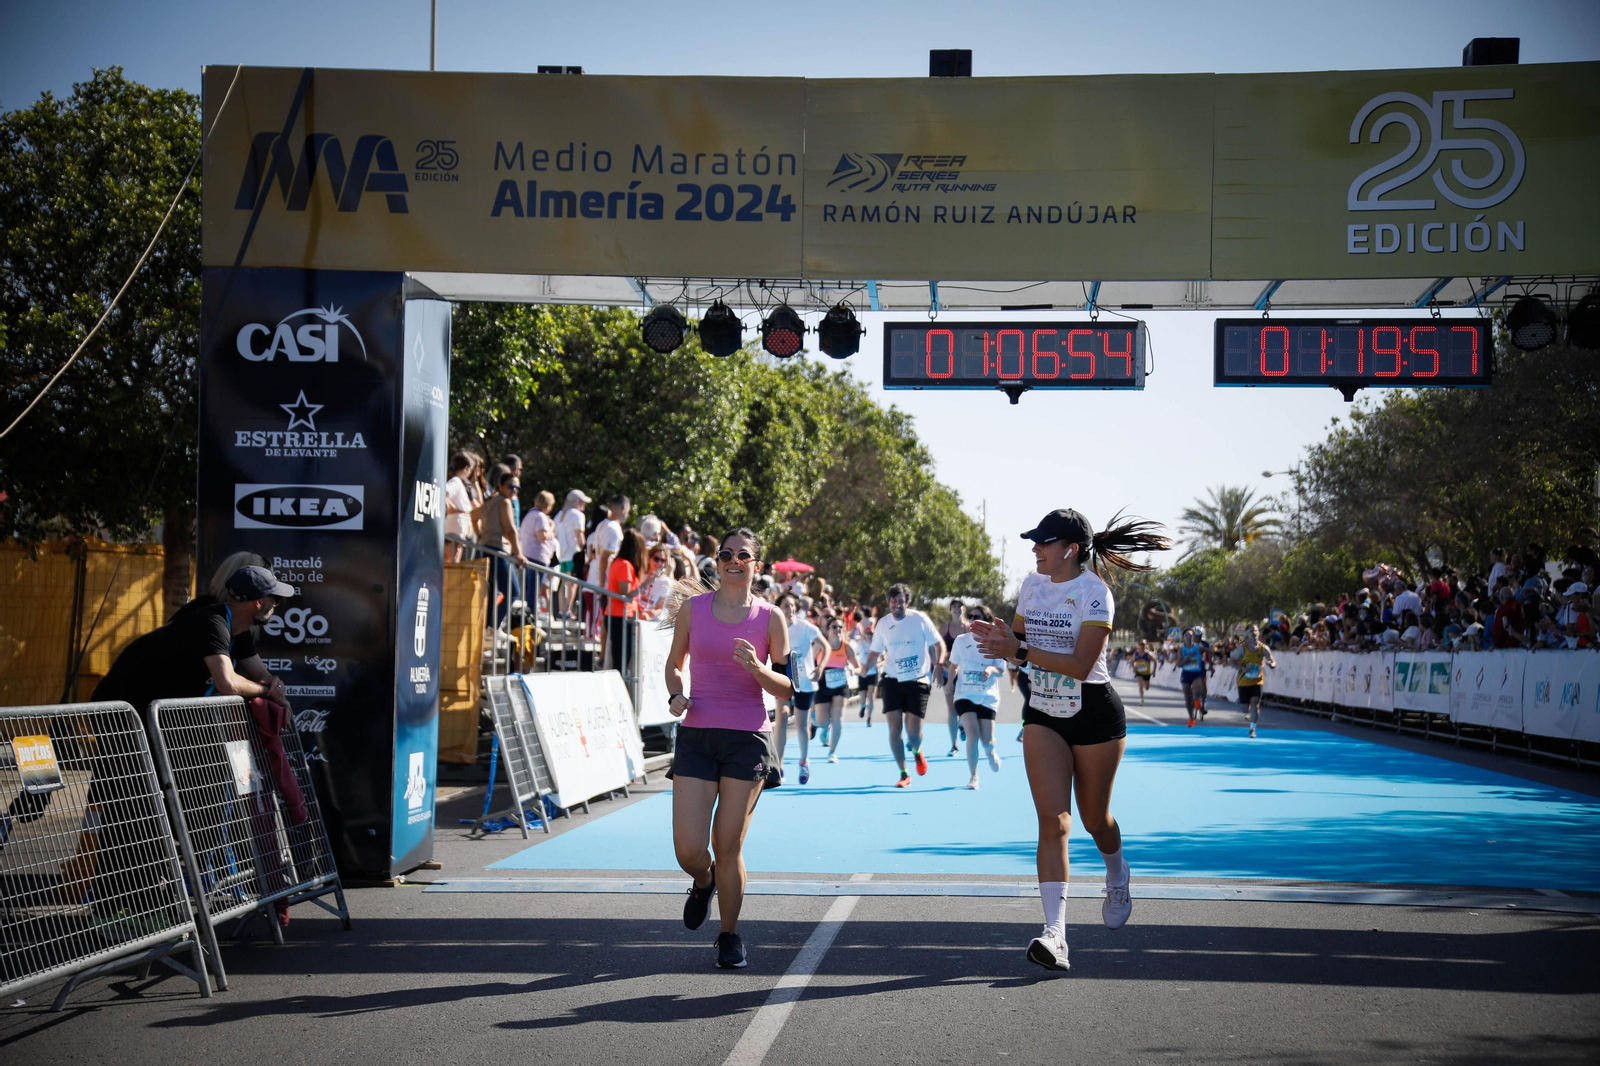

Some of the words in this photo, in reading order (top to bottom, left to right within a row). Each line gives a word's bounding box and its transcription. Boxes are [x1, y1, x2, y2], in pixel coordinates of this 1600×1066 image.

[415, 139, 460, 170] 25
[493, 141, 612, 172] Medio
[631, 144, 796, 176] Maratón
[1348, 88, 1526, 212] 25
[414, 171, 459, 183] EDICIÓN
[896, 171, 959, 180] SERIES
[891, 183, 930, 192] RUTA
[935, 183, 997, 193] RUNNING
[490, 179, 665, 220] Almería
[674, 183, 797, 222] 2024
[823, 201, 921, 224] RAMÓN
[933, 205, 996, 224] RUIZ
[1006, 201, 1138, 224] ANDÚJAR
[1347, 215, 1526, 255] EDICIÓN
[236, 322, 339, 363] CASI
[1260, 326, 1478, 377] 01:19:57
[926, 329, 1132, 379] 01:06:54
[234, 430, 367, 449] ESTRELLA
[265, 448, 282, 457] DE
[283, 448, 337, 458] LEVANTE
[253, 497, 349, 517] IKEA
[273, 556, 322, 569] Barceló
[273, 570, 305, 582] Cabo
[307, 570, 324, 582] de
[1042, 611, 1072, 619] Maratón
[1049, 619, 1072, 628] 2024
[263, 607, 329, 644] ego
[305, 637, 317, 645] sport
[1034, 670, 1076, 690] 5174
[287, 687, 298, 695] de
[299, 687, 334, 696] Almería
